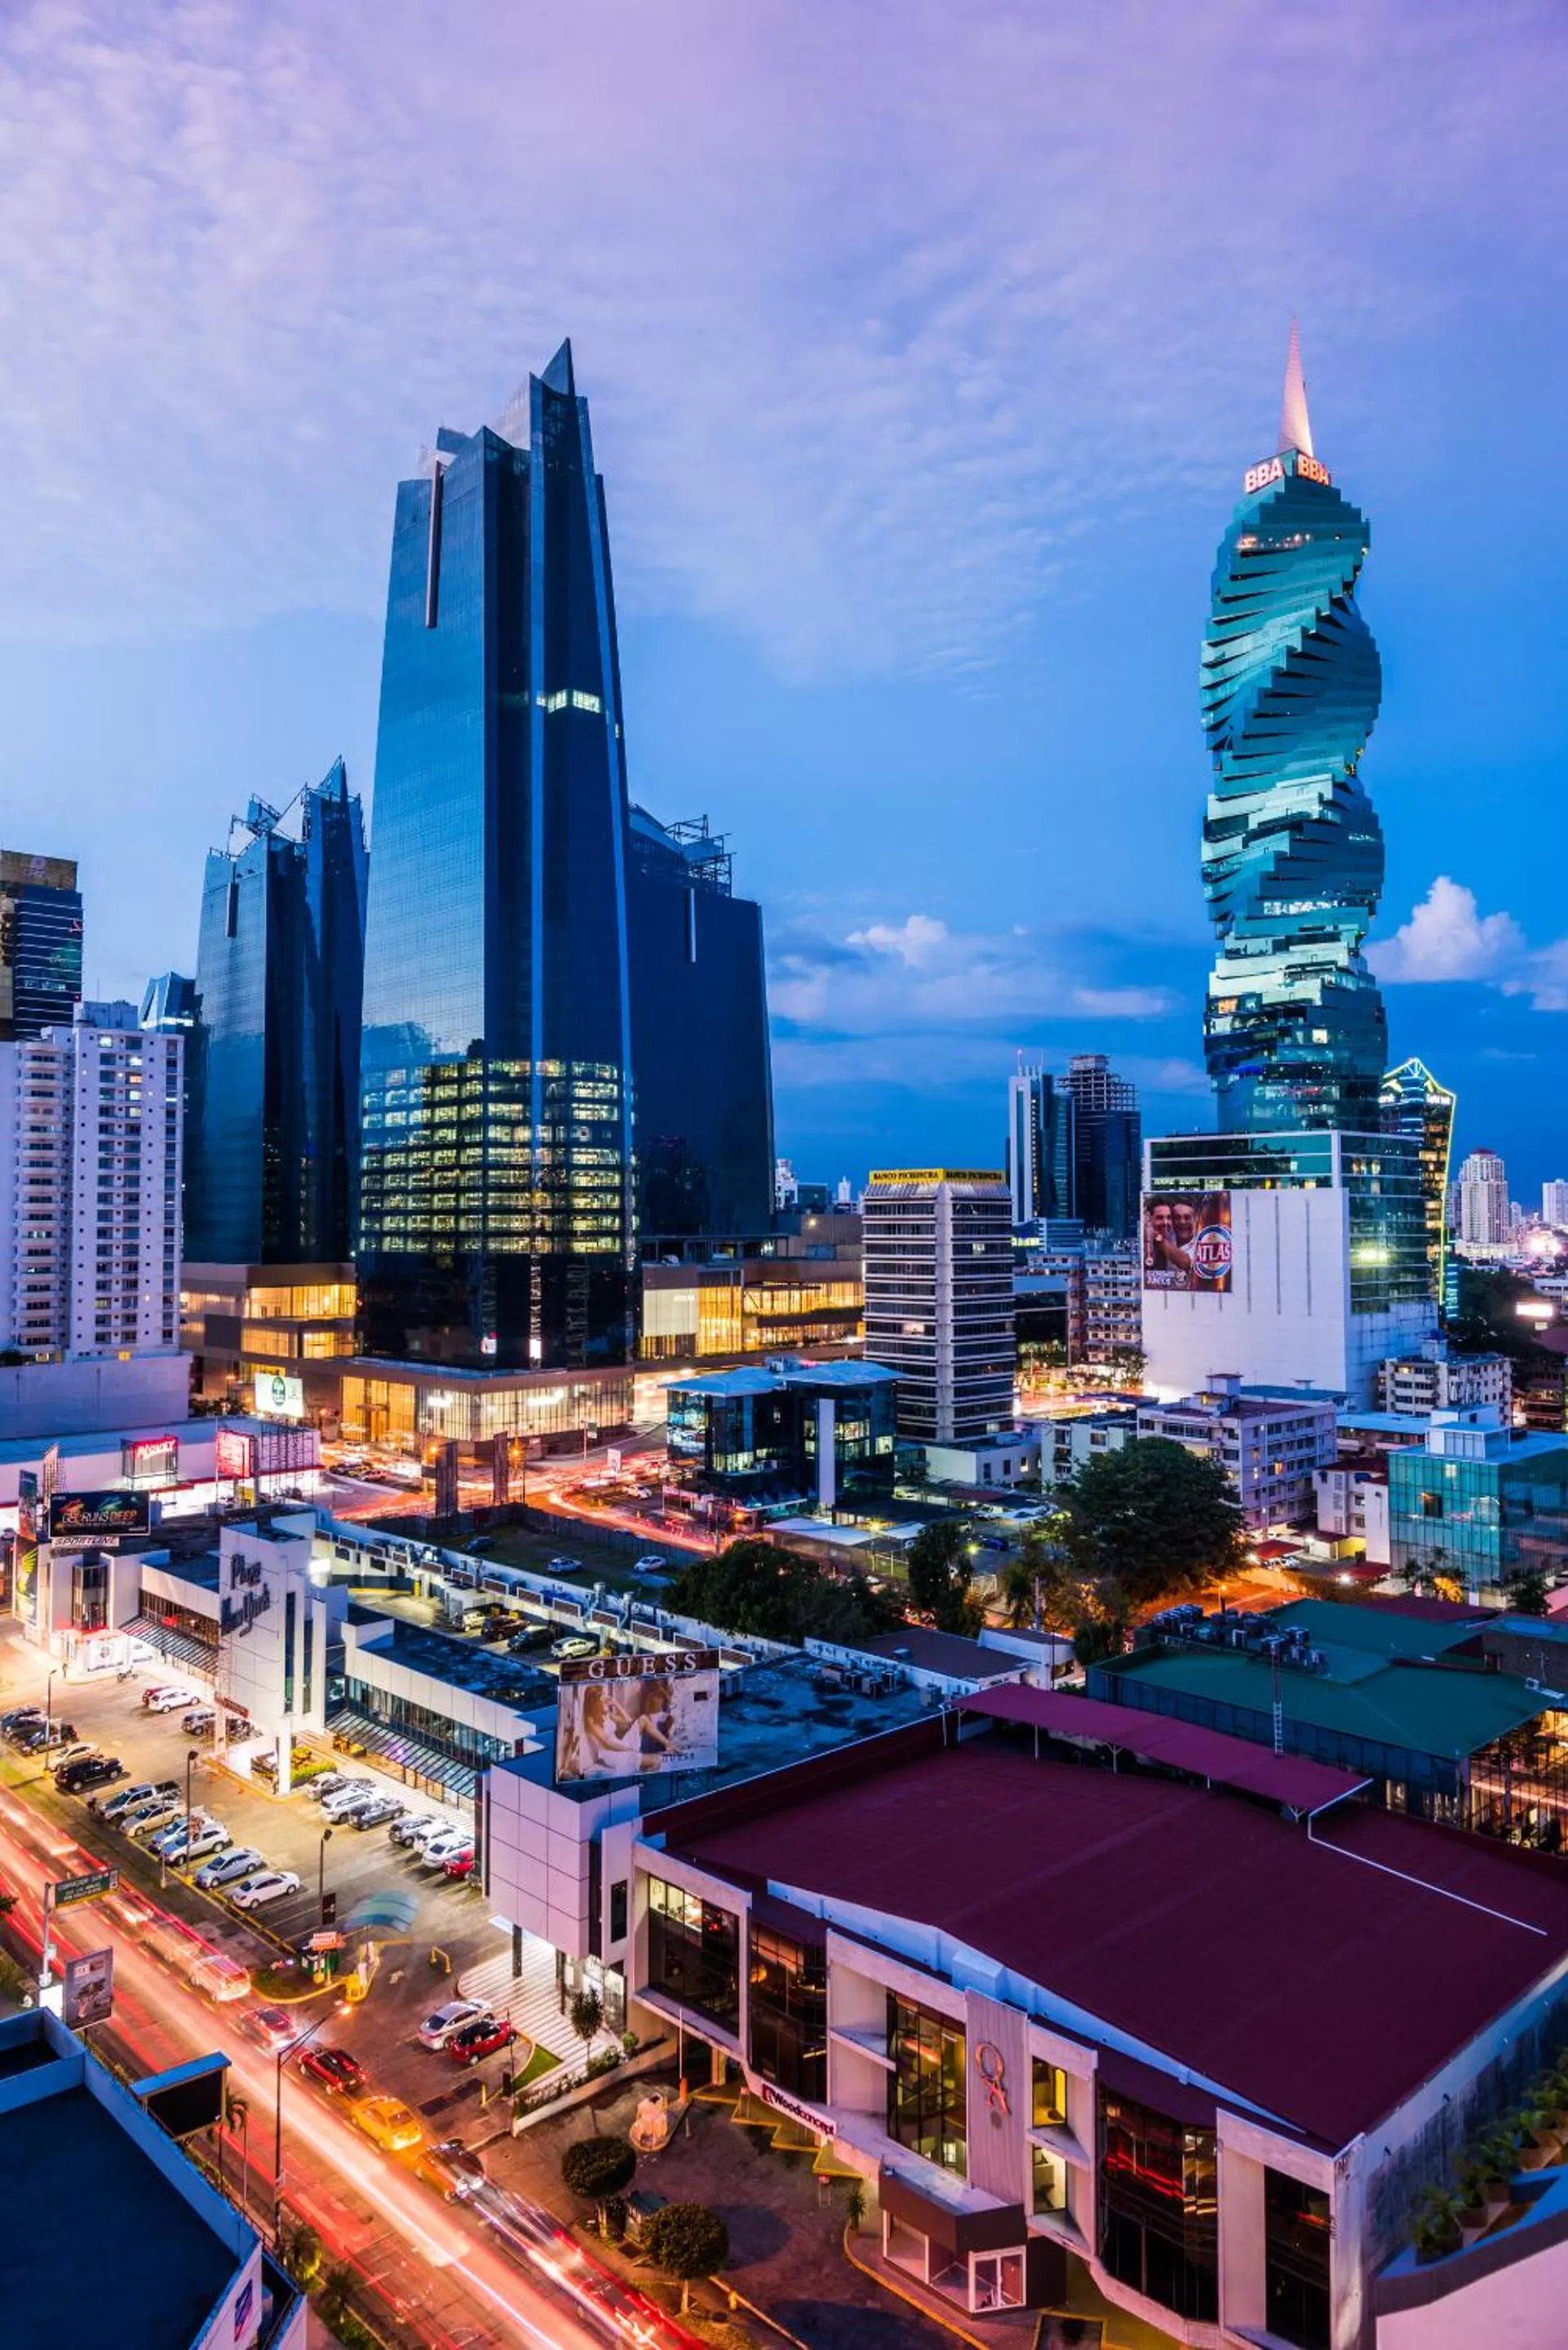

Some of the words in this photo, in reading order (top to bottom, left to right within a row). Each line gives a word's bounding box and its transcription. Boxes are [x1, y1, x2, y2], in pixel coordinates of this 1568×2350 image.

[1196, 1243, 1230, 1262] ATLAS
[588, 1654, 696, 1678] GUESS
[775, 2093, 834, 2135] Woodconcept
